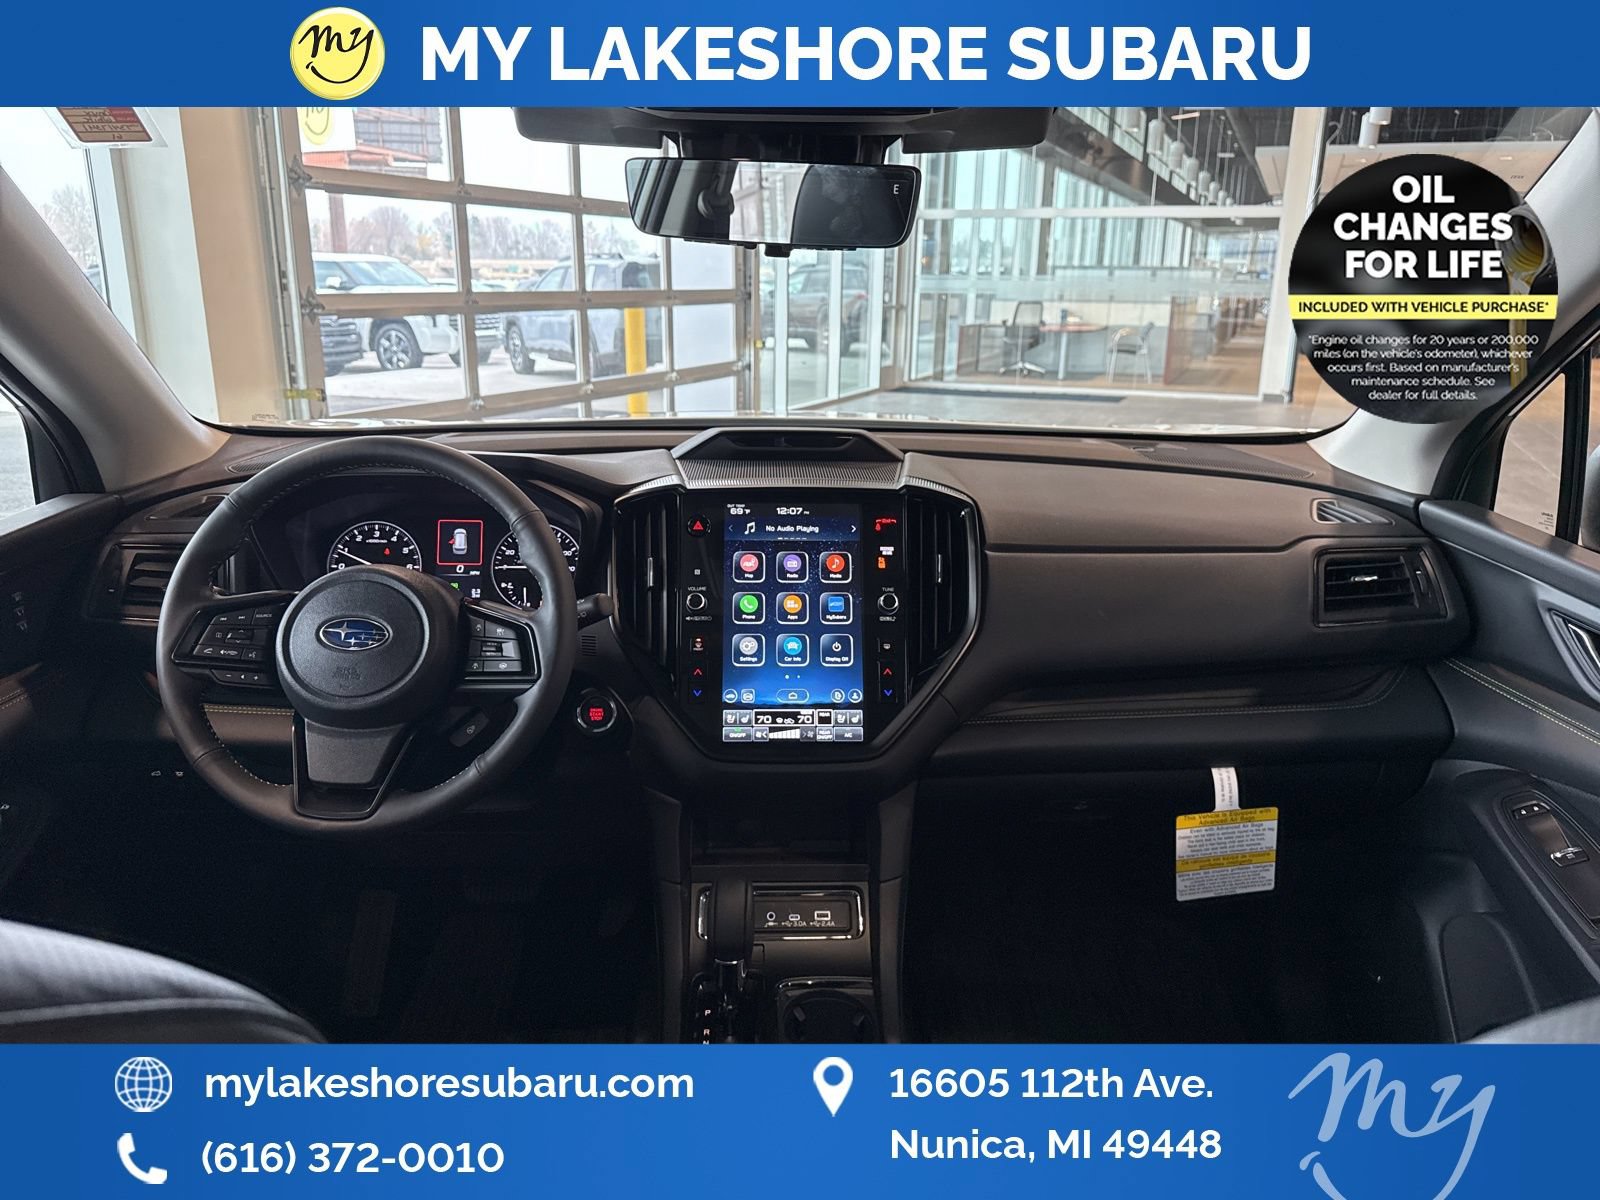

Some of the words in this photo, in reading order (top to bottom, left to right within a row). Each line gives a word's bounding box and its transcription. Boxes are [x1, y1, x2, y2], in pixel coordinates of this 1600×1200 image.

[893, 184, 900, 195] E
[730, 507, 744, 515] 69
[776, 507, 803, 515] 12:07
[373, 530, 380, 538] 3
[796, 525, 819, 534] Playing
[456, 564, 465, 573] 0
[756, 715, 772, 724] 70
[797, 715, 813, 724] 70
[703, 1028, 710, 1036] R
